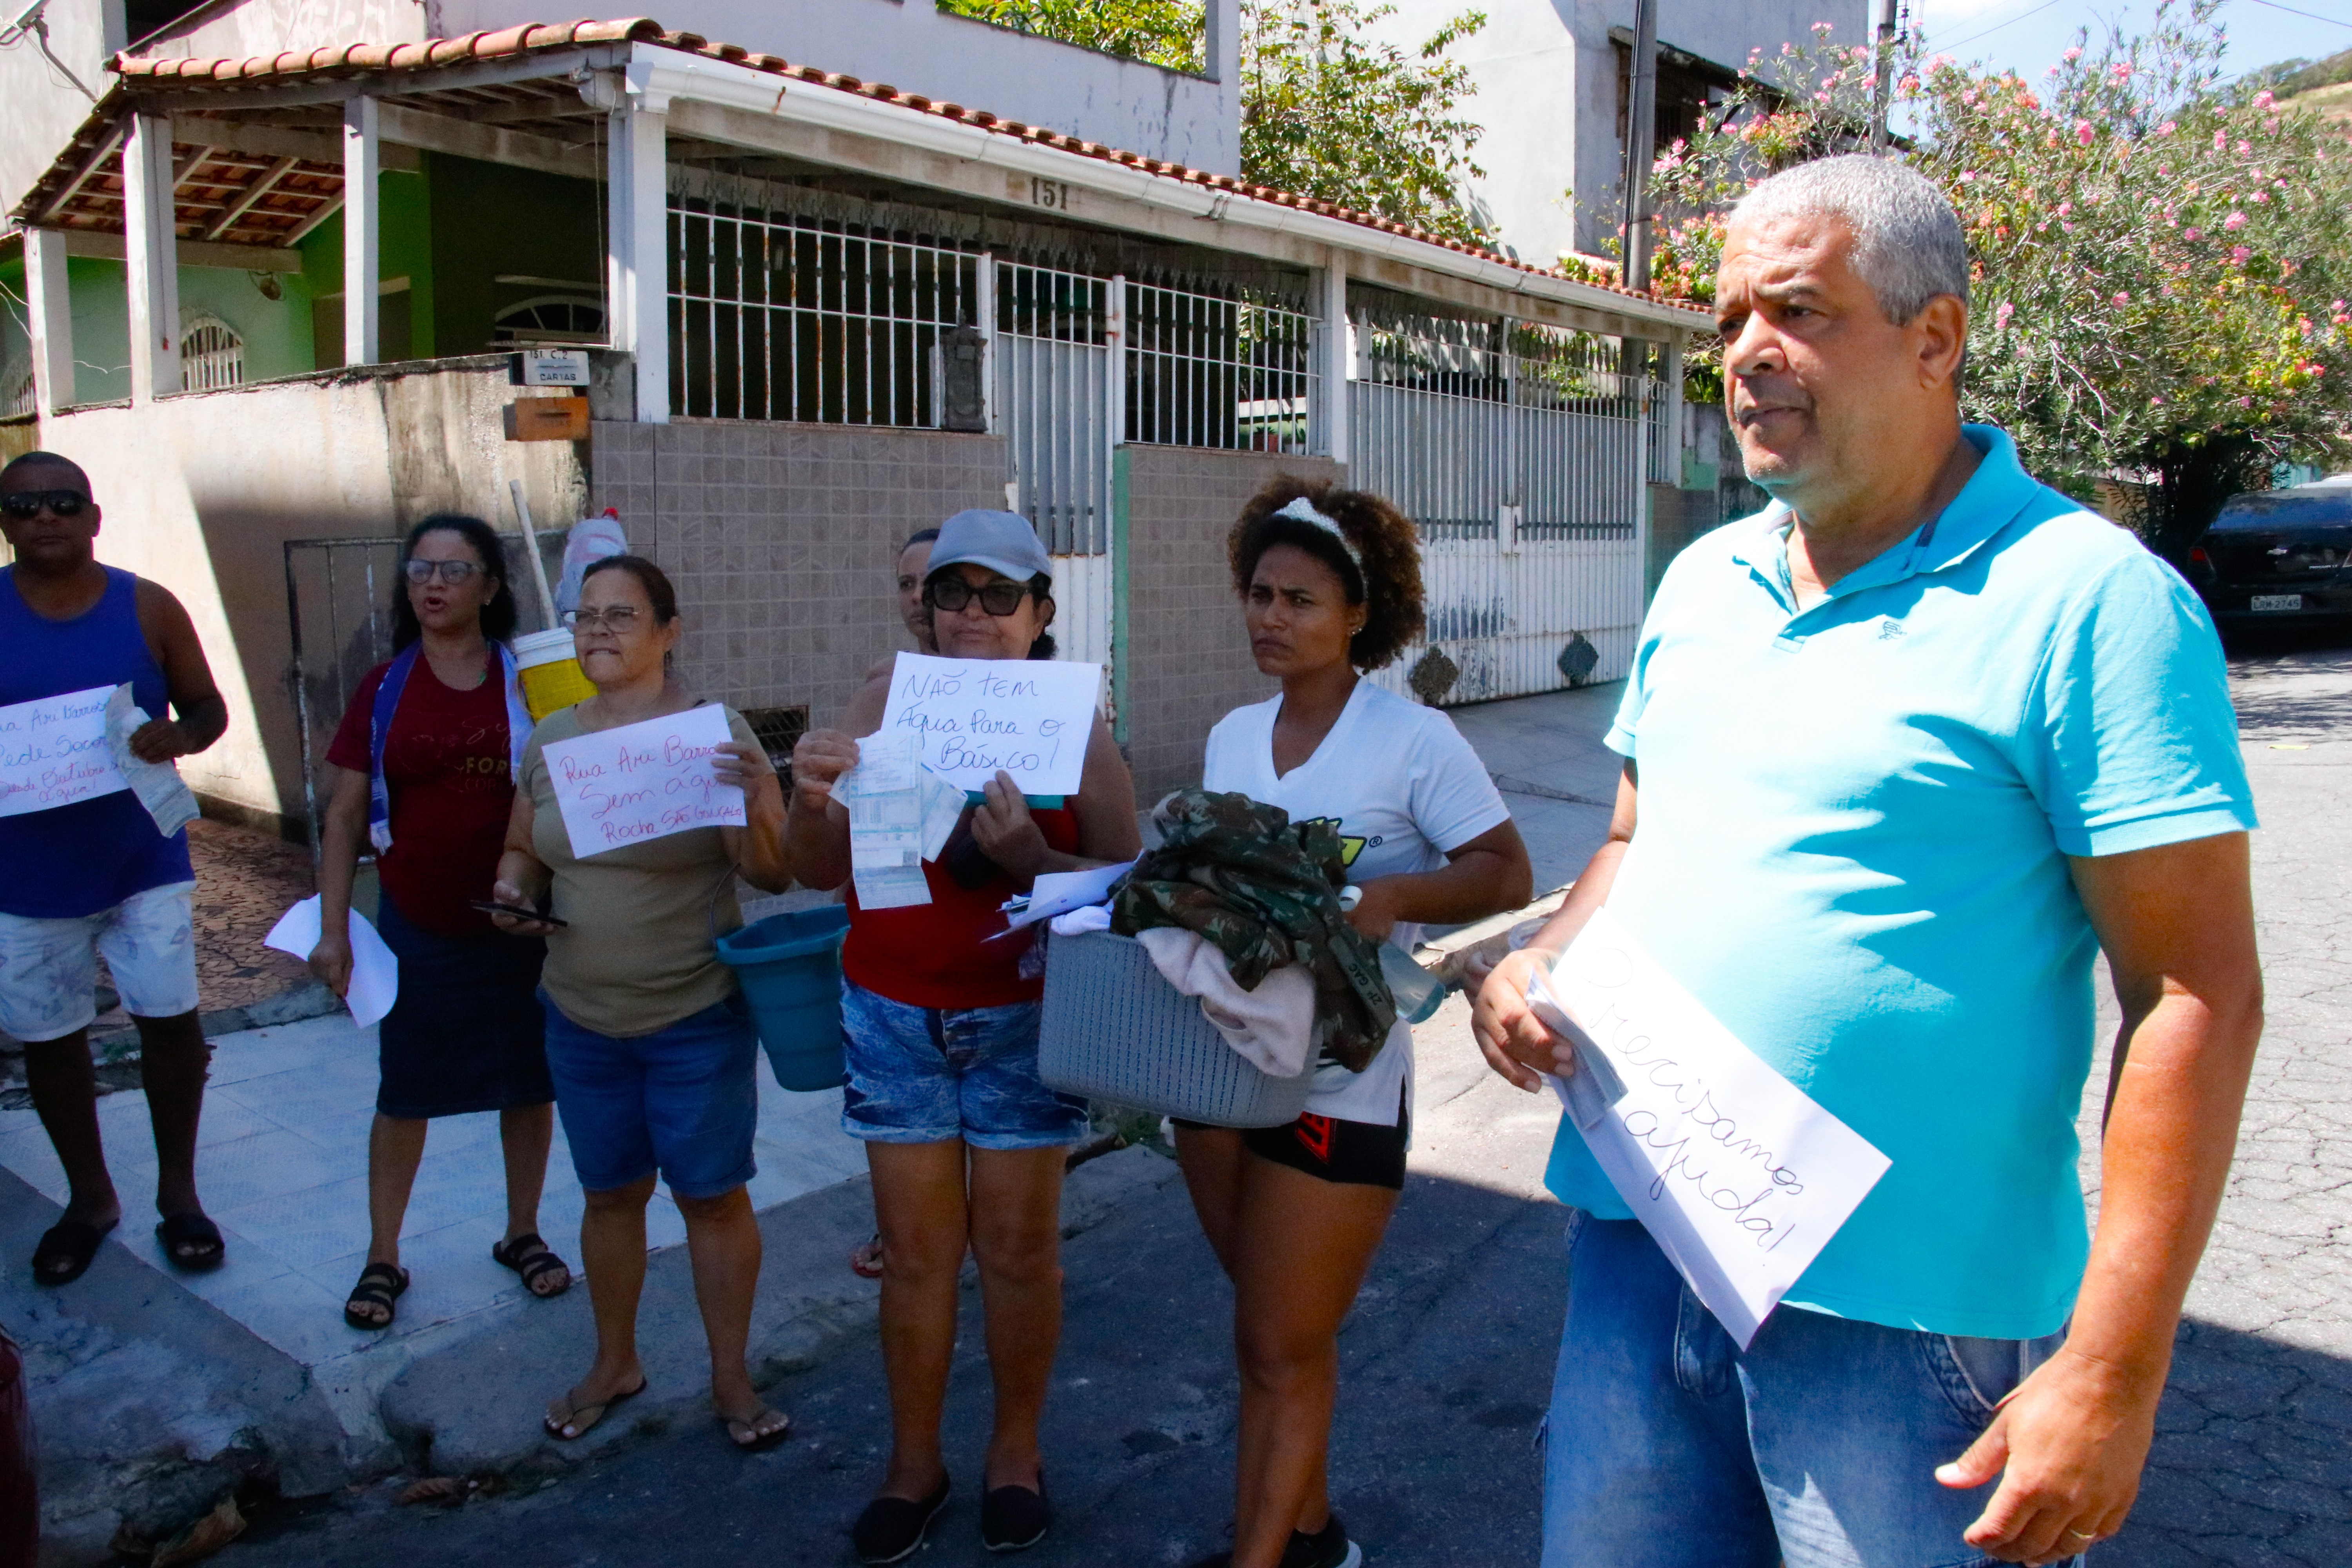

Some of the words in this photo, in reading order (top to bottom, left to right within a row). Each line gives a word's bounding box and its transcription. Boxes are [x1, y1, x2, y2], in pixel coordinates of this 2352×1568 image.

[1031, 177, 1067, 210] 151
[902, 669, 967, 699] NÃO
[559, 756, 606, 784] Rua
[664, 735, 717, 766] Barro
[579, 784, 655, 820] Sem
[665, 766, 720, 803] águ
[601, 821, 658, 844] Rocha
